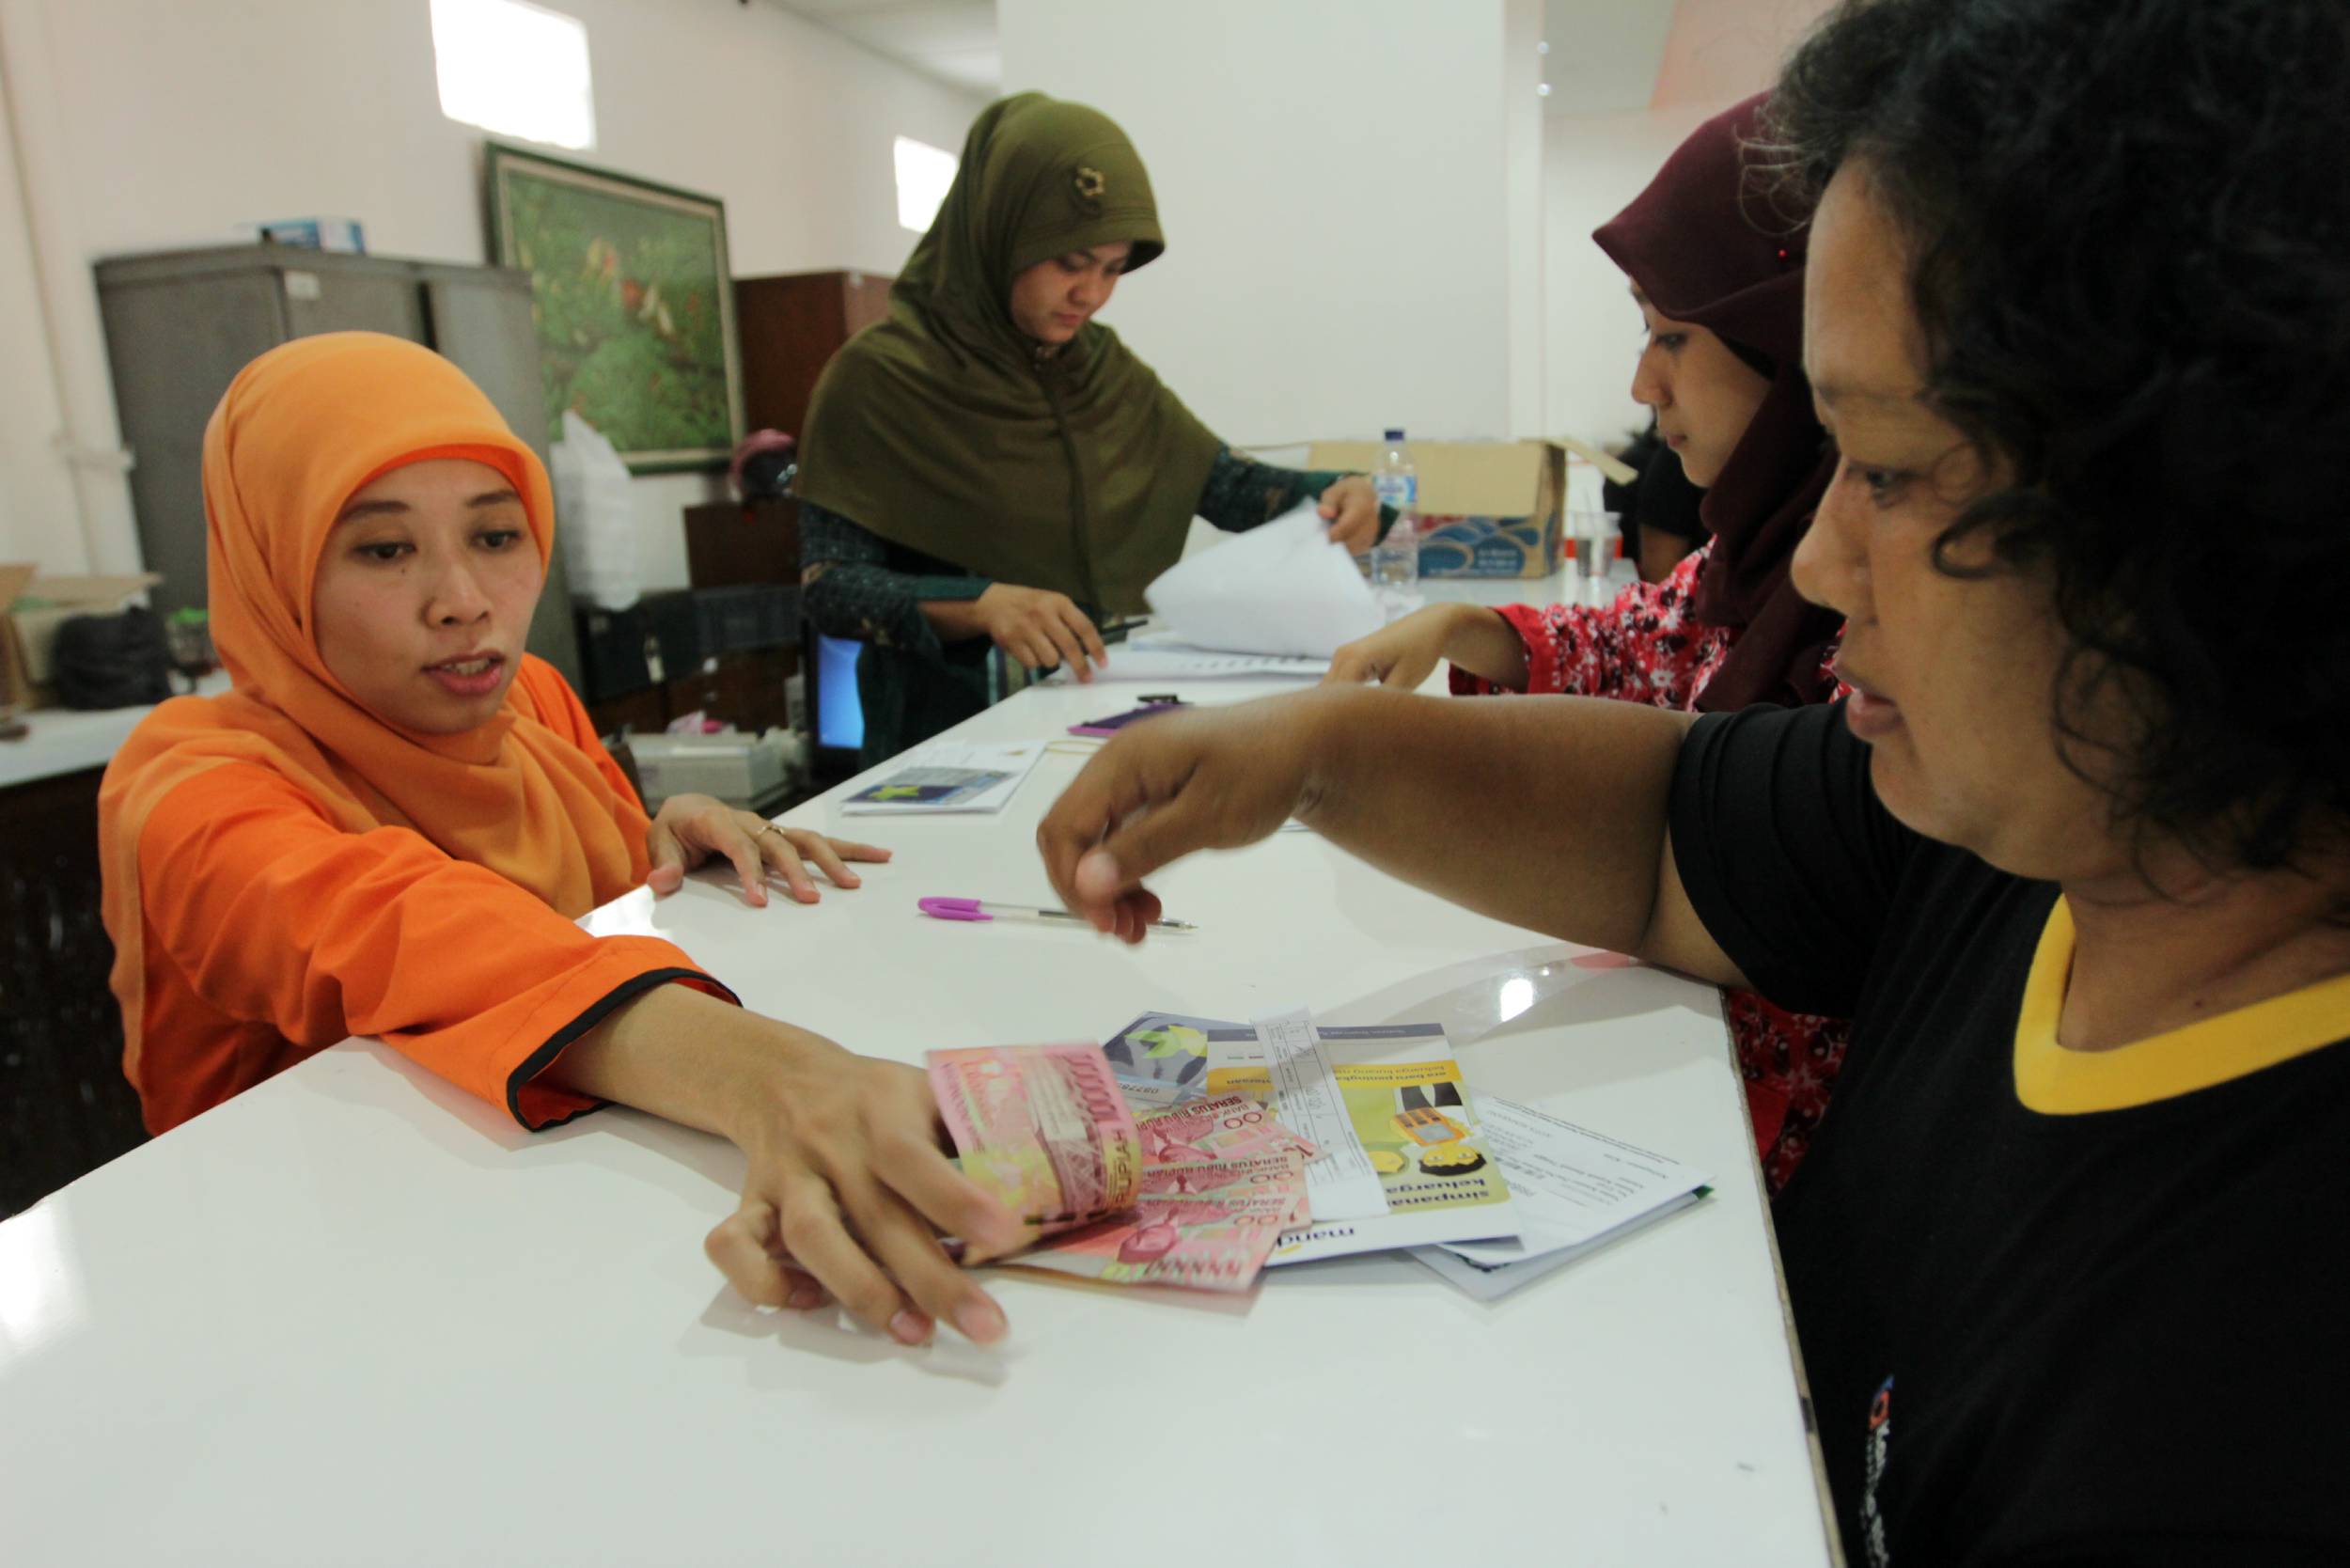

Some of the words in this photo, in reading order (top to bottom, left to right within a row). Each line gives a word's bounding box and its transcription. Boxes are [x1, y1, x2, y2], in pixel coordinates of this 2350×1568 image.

[1191, 1096, 1242, 1114] SERATUS
[1136, 1116, 1164, 1131] RUPI
[1230, 1156, 1288, 1168] SERATUS
[1386, 1178, 1485, 1193] keluarga
[1277, 1228, 1355, 1247] mand
